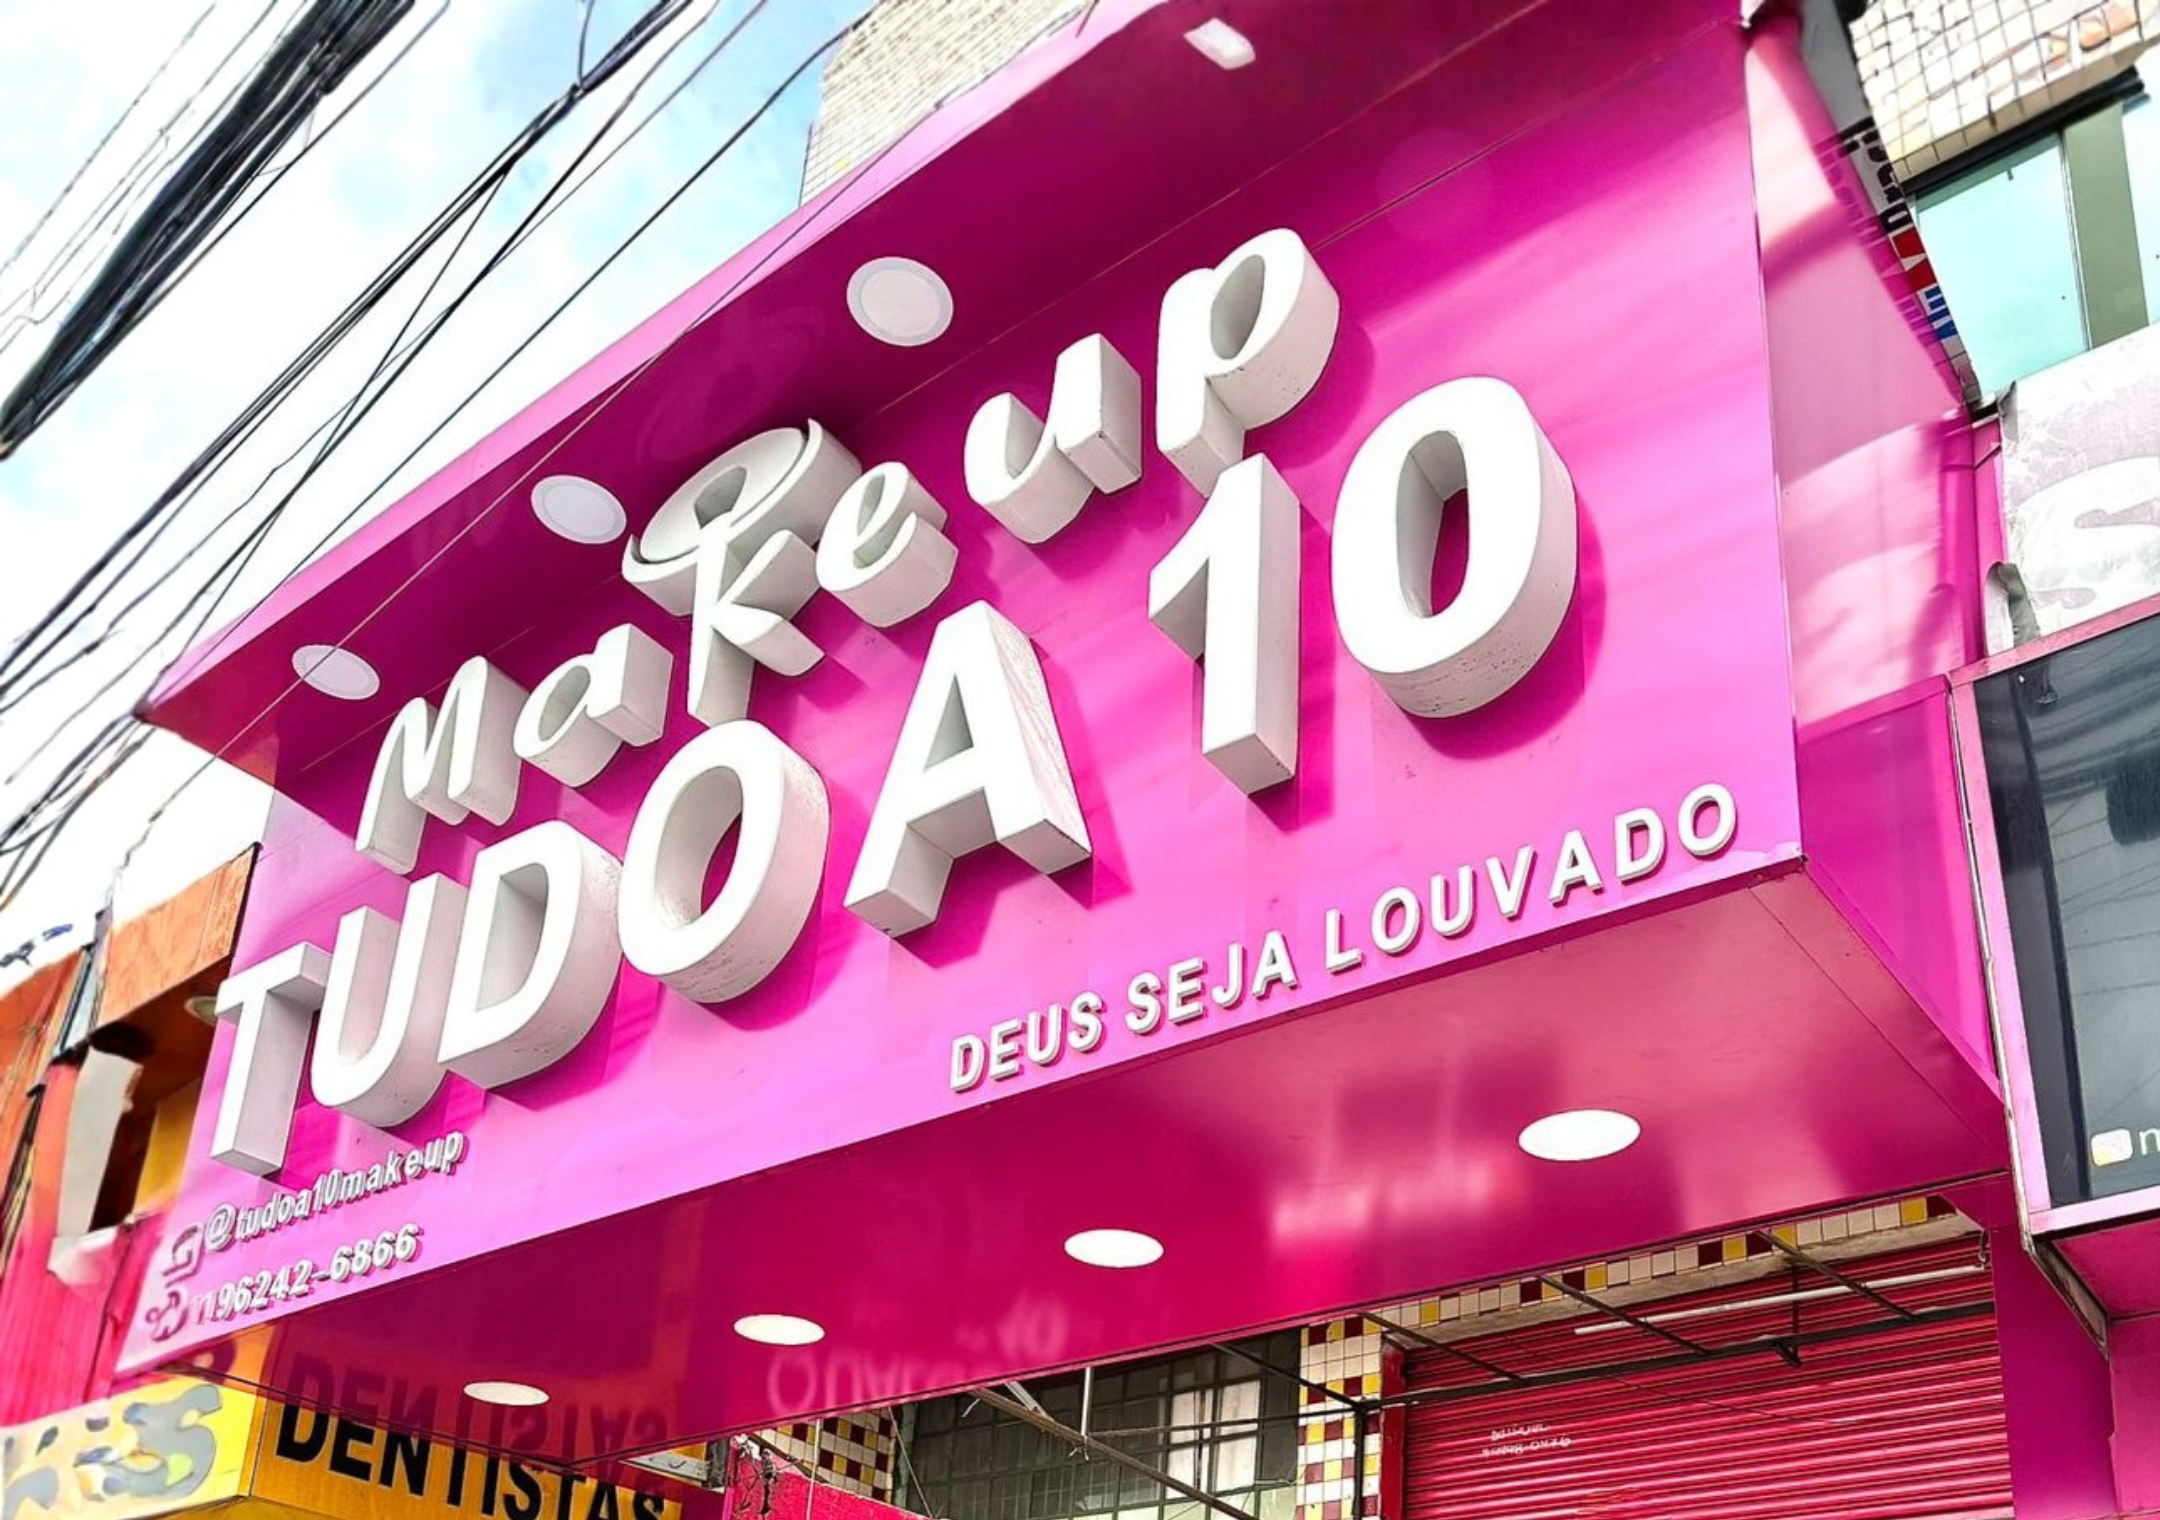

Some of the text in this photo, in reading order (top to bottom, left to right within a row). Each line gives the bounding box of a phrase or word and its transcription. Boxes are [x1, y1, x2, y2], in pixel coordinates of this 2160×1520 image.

[965, 228, 1338, 543] up
[208, 376, 1577, 1175] TUDO A 10
[949, 784, 1738, 1092] DEUS SEJA LOUVADO
[204, 1131, 465, 1250] @tudoa10makeup
